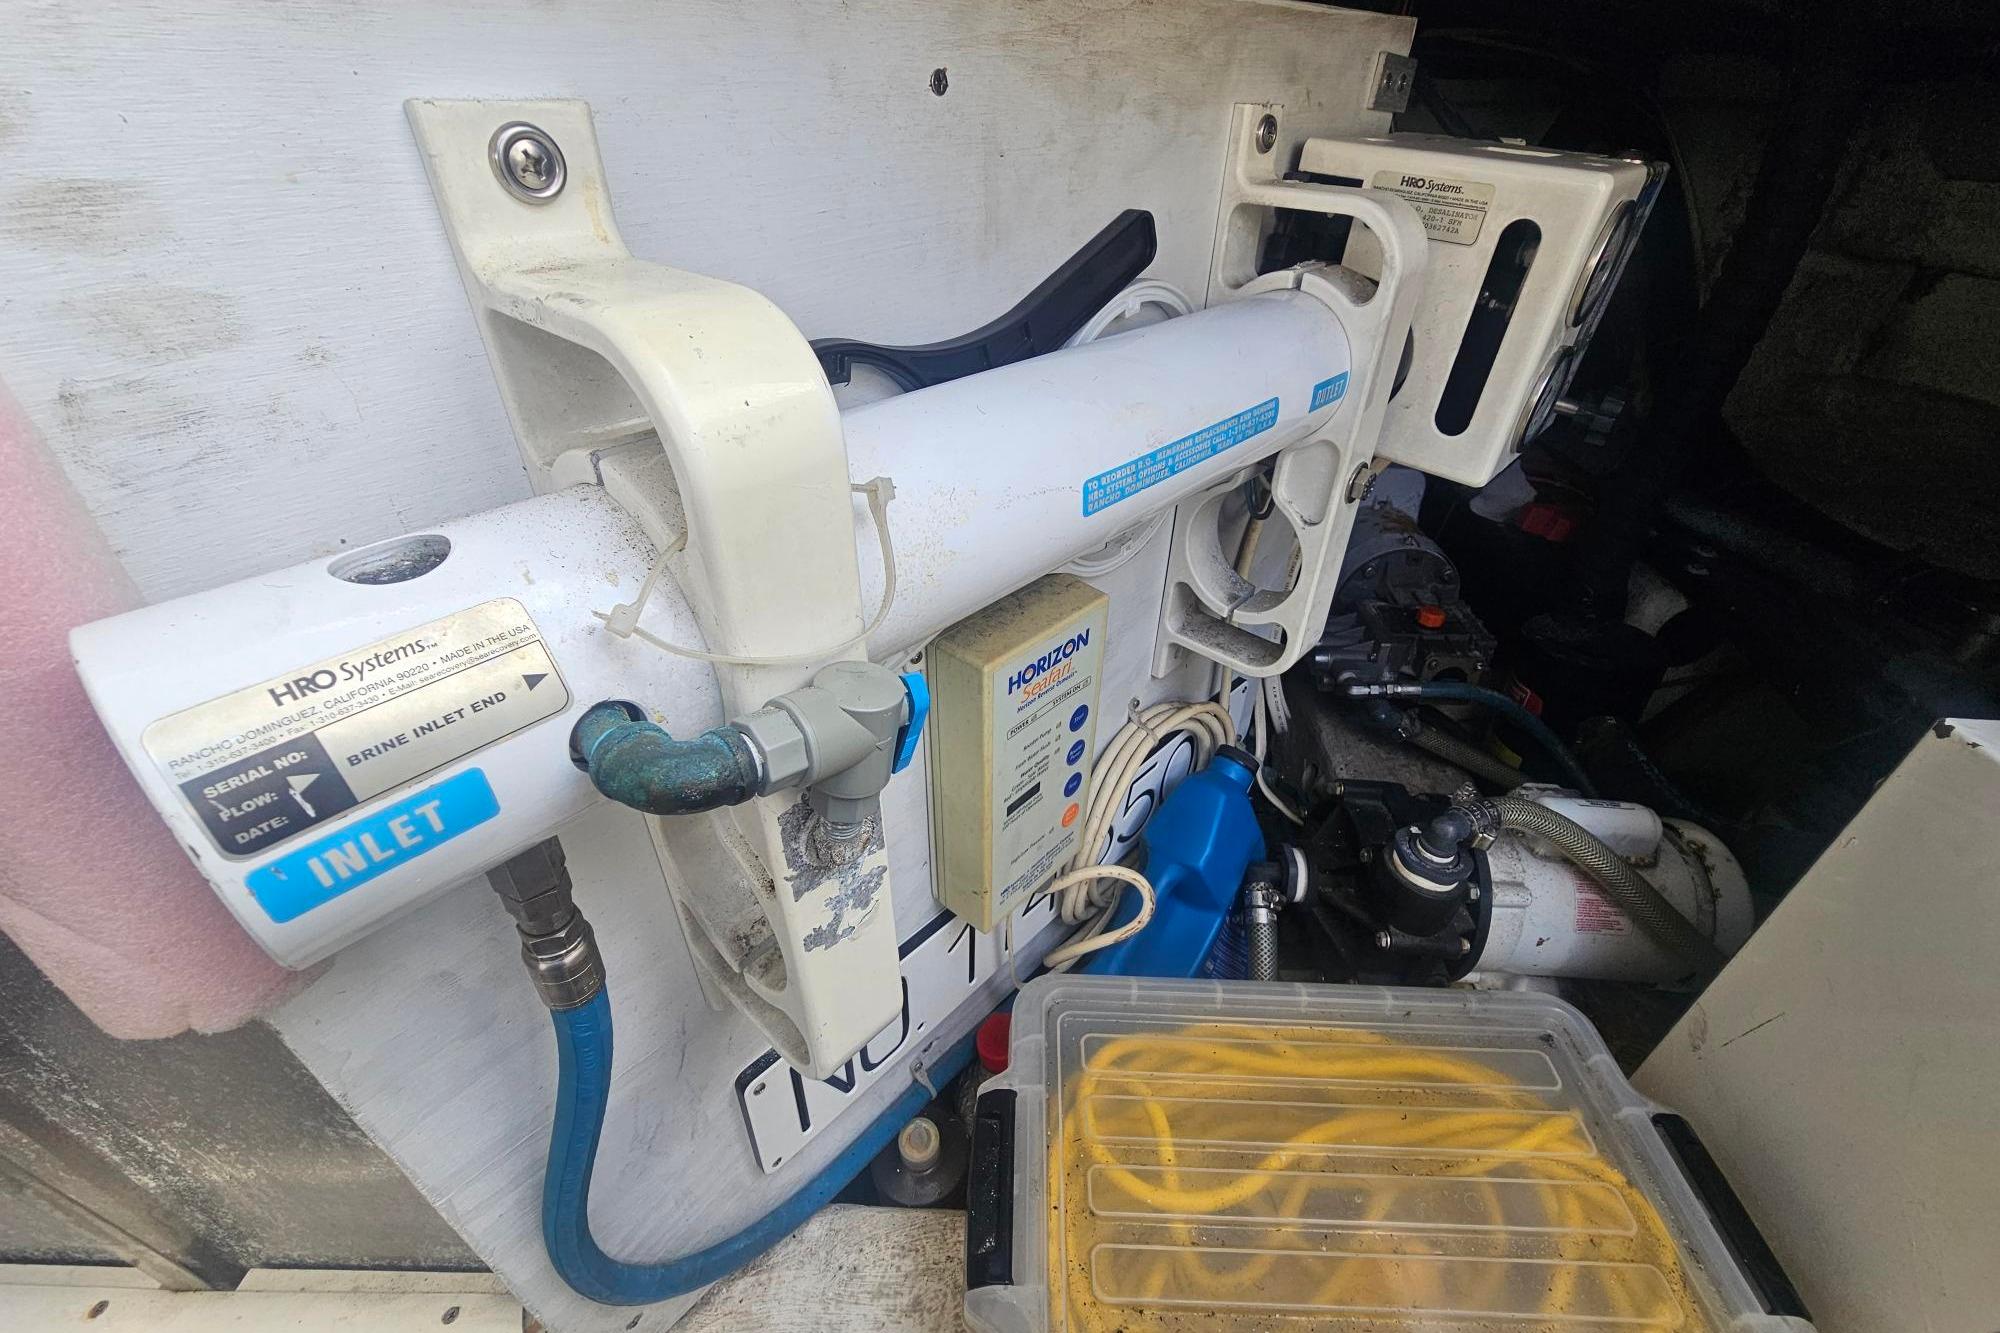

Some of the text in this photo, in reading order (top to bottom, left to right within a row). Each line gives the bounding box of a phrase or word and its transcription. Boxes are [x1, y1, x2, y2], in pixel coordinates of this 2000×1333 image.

[1400, 176, 1426, 189] HRO
[1316, 380, 1344, 406] OUTLET
[1087, 479, 1099, 492] TO
[1100, 464, 1136, 487] REORDER
[1088, 487, 1104, 501] HRO
[1106, 473, 1138, 496] SYSTEMS
[1138, 461, 1167, 482] OPTIONS
[1174, 441, 1211, 464] ACCESSORIES
[1087, 492, 1121, 513] RANCHO
[268, 668, 338, 708] HRO
[388, 680, 418, 696] E-Mail:
[418, 632, 537, 686] searecovery@searecovery.com
[1008, 628, 1090, 696] HORIZON
[1021, 658, 1072, 704] Seafari
[168, 624, 532, 770] RANCHO DOMINGUEZ, CALIFORNIA 90220 MADE IN THE USA
[1010, 684, 1082, 736] POWER SYSTEM ON
[346, 690, 506, 768] BRINE INLET END
[202, 749, 308, 801] SERIAL NO:
[234, 814, 290, 845] DATE:
[308, 799, 448, 889] INLET
